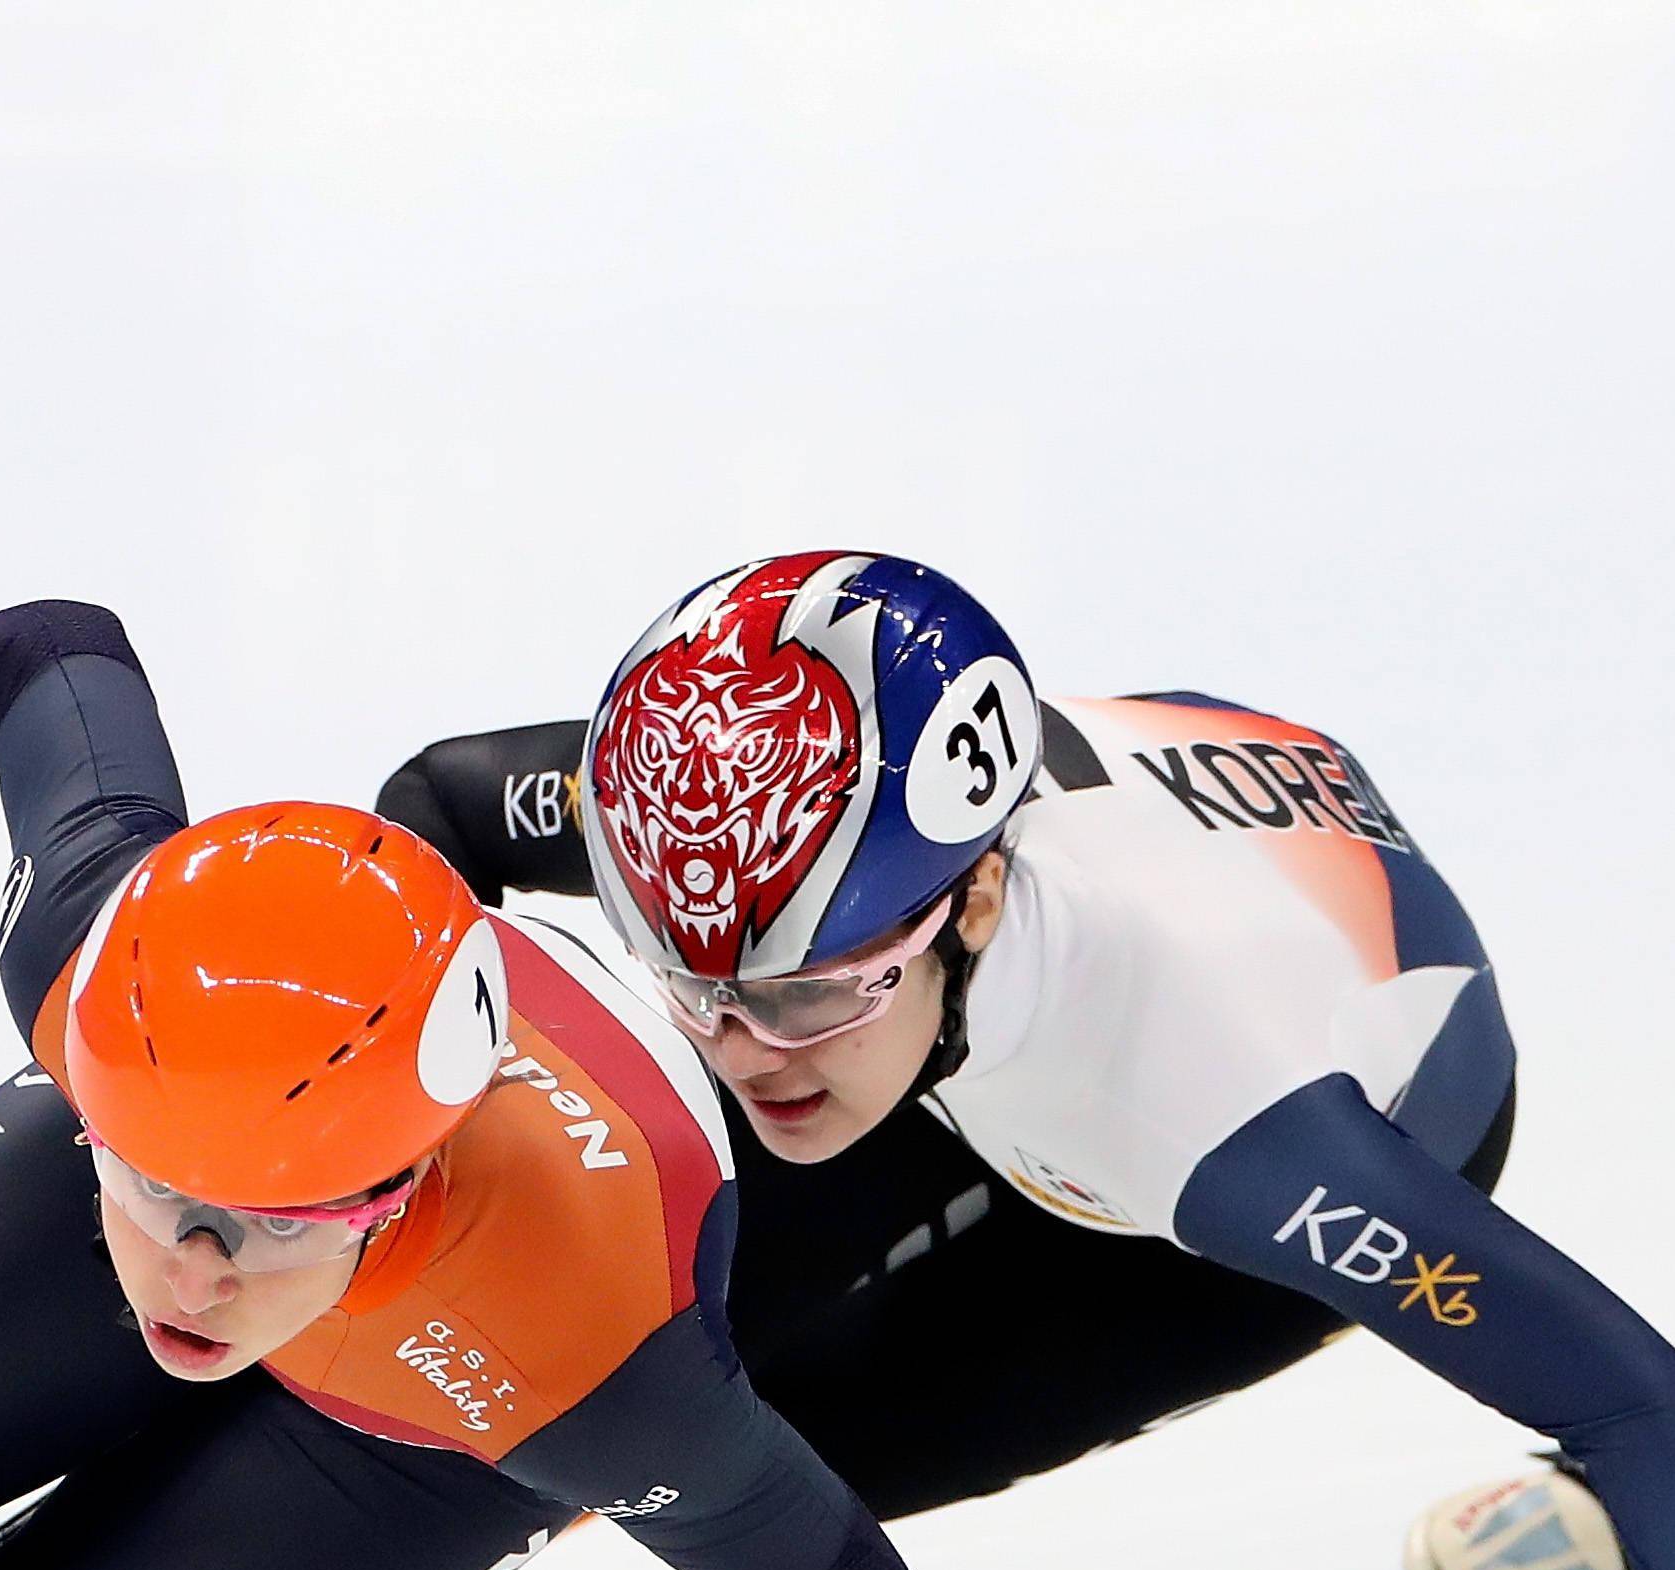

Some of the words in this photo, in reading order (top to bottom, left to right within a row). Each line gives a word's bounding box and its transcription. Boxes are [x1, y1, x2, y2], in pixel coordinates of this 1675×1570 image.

[946, 681, 1022, 808] 37
[474, 966, 497, 1050] 1
[396, 1336, 491, 1431] Vitality
[426, 1320, 516, 1411] a.s.r.
